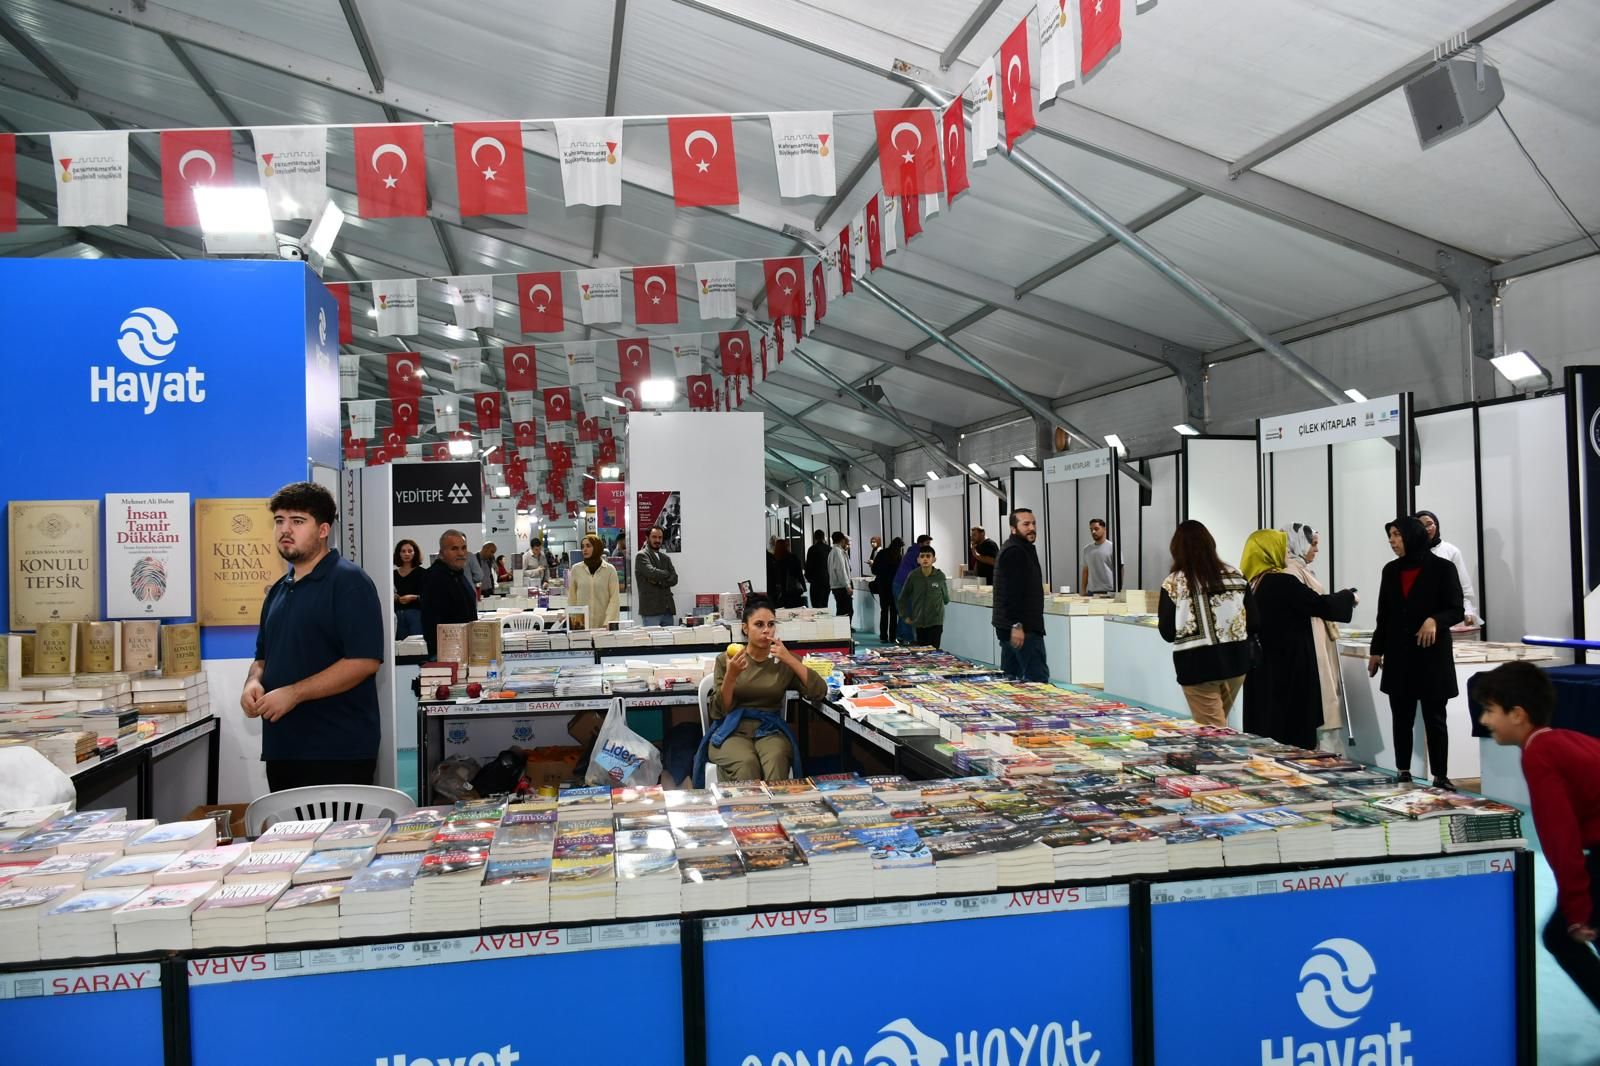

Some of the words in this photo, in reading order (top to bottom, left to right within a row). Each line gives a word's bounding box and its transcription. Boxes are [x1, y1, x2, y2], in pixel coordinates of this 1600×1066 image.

[90, 366, 206, 414] Hayat
[1298, 422, 1319, 436] ÇİLEK
[1320, 416, 1357, 432] KİTAPLAR
[396, 488, 444, 504] YEDİTEPE
[127, 506, 168, 520] İnsan
[126, 520, 170, 532] Tamir
[117, 532, 180, 544] Dükkânı
[213, 543, 272, 557] KUR'AN
[20, 558, 88, 574] KONULU
[222, 558, 263, 570] BANA
[25, 574, 84, 589] TEFSİR
[214, 572, 229, 580] NE
[232, 570, 272, 580] DİYOR?
[528, 702, 562, 710] SARAY
[602, 740, 636, 762] Lider
[1282, 873, 1346, 892] SARAY
[751, 908, 828, 930] SARAY
[1008, 888, 1080, 907] SARAY
[474, 930, 560, 952] SARAY
[52, 972, 147, 994] SARAY
[1260, 1022, 1414, 1066] Hayat
